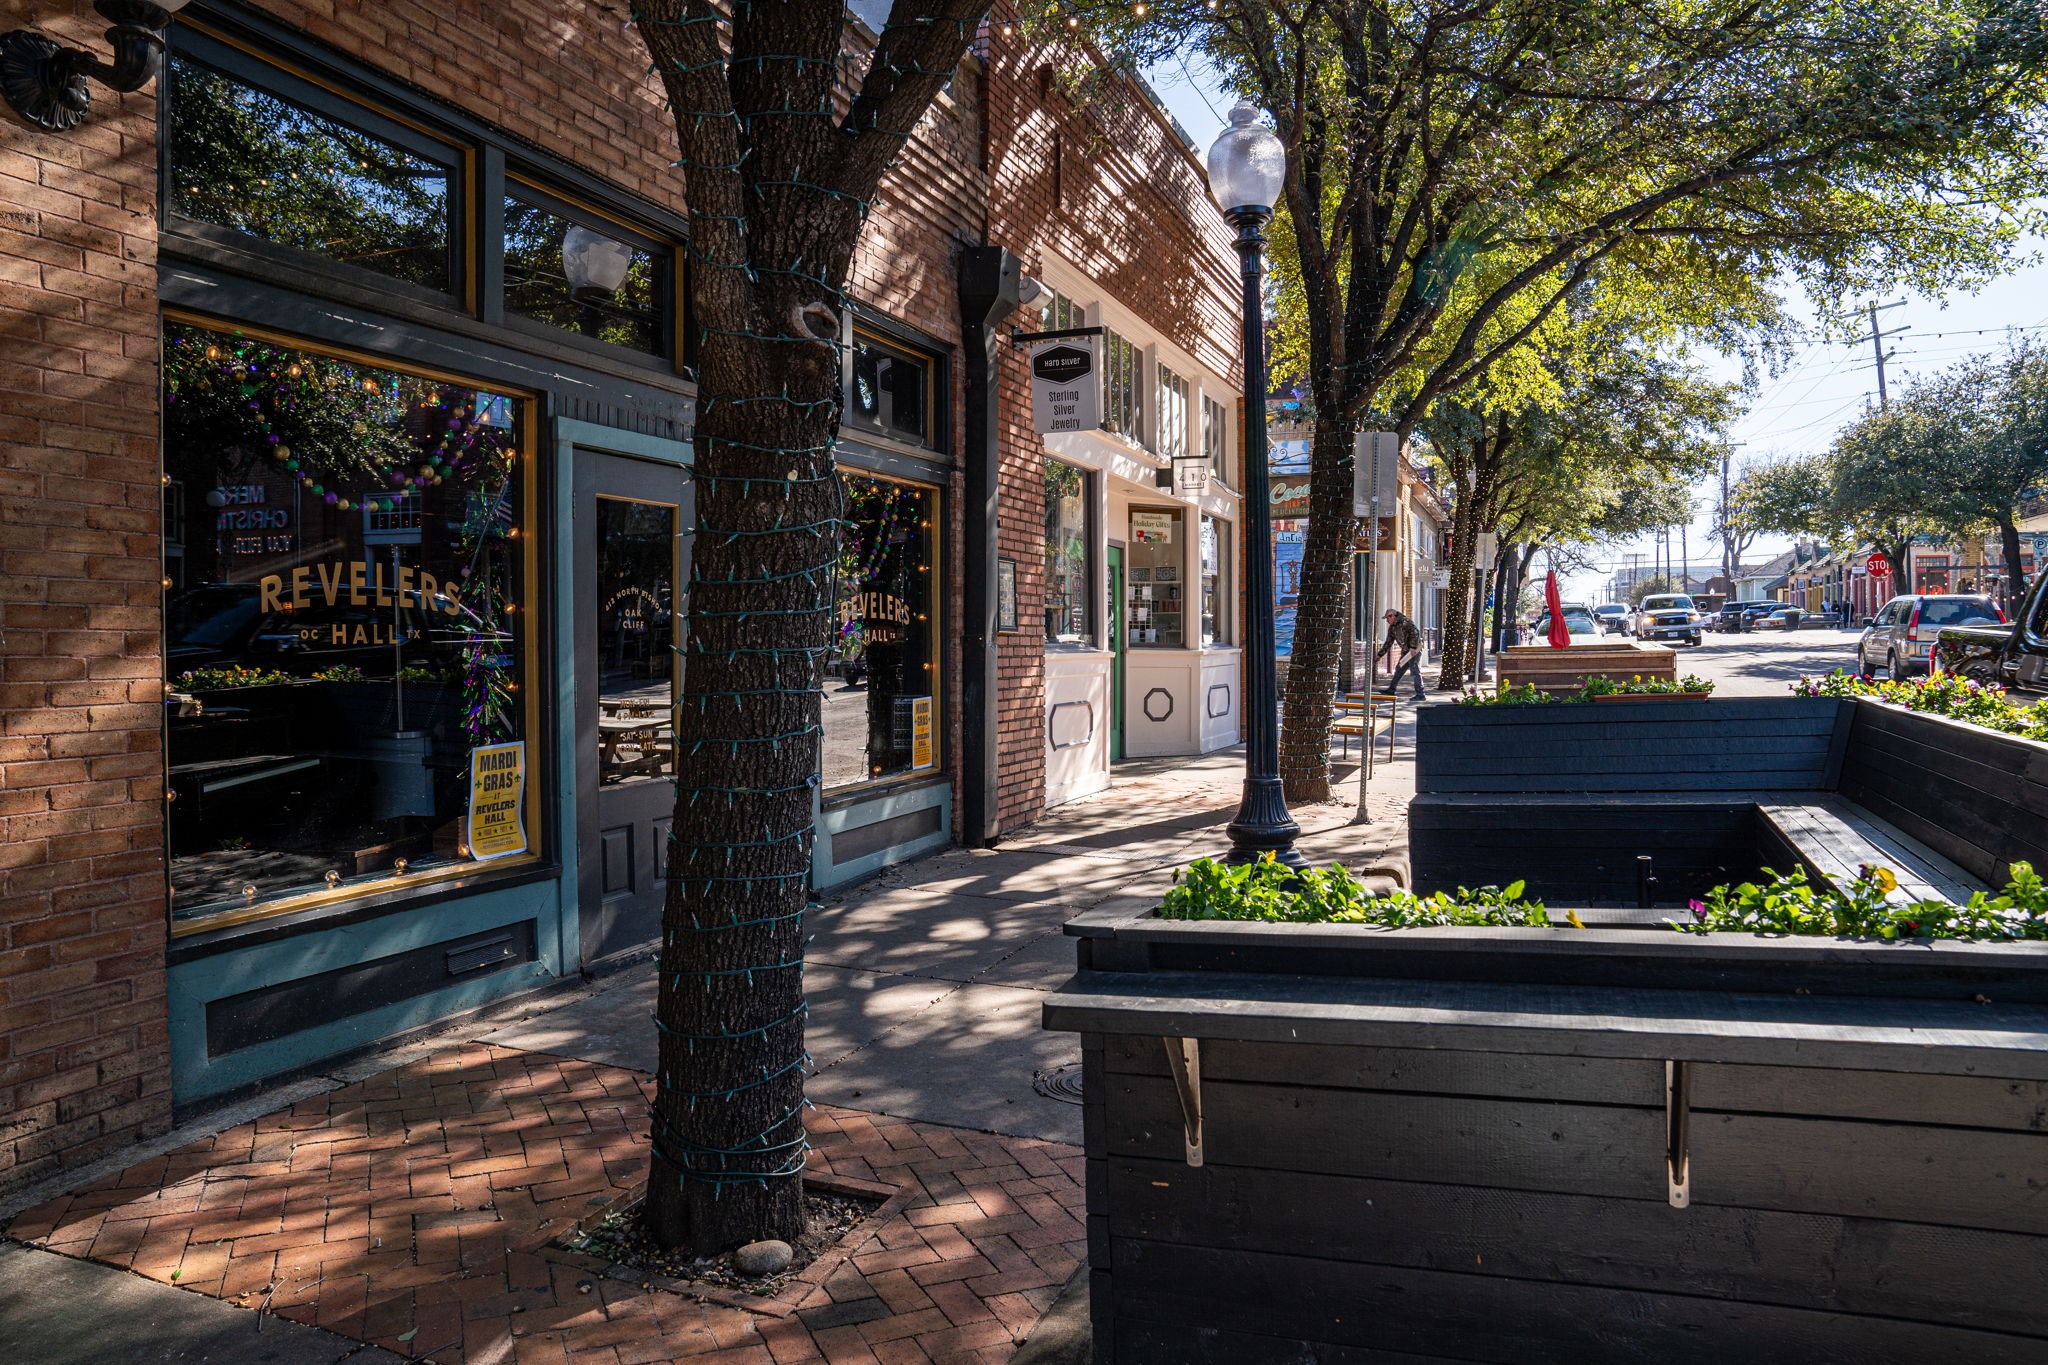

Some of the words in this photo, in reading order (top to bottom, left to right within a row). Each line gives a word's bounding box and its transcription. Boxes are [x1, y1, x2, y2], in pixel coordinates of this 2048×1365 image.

[1048, 390, 1079, 402] Sterling
[1053, 404, 1075, 416] Silver
[1050, 418, 1080, 430] Jewelry
[1133, 520, 1155, 529] Holiday
[1155, 521, 1171, 529] Gifts
[260, 561, 460, 616] REVELERS
[616, 586, 639, 600] NORTH
[624, 608, 642, 617] OAK
[840, 591, 910, 625] REVELERS
[622, 620, 645, 629] CLIFF
[300, 629, 319, 640] OC
[332, 624, 399, 645] HALL
[406, 629, 421, 640] TX
[864, 629, 888, 642] HALL
[480, 750, 517, 773] MARDI
[483, 771, 513, 792] GRAS
[475, 799, 516, 815] REVELERS
[484, 811, 506, 825] HALL
